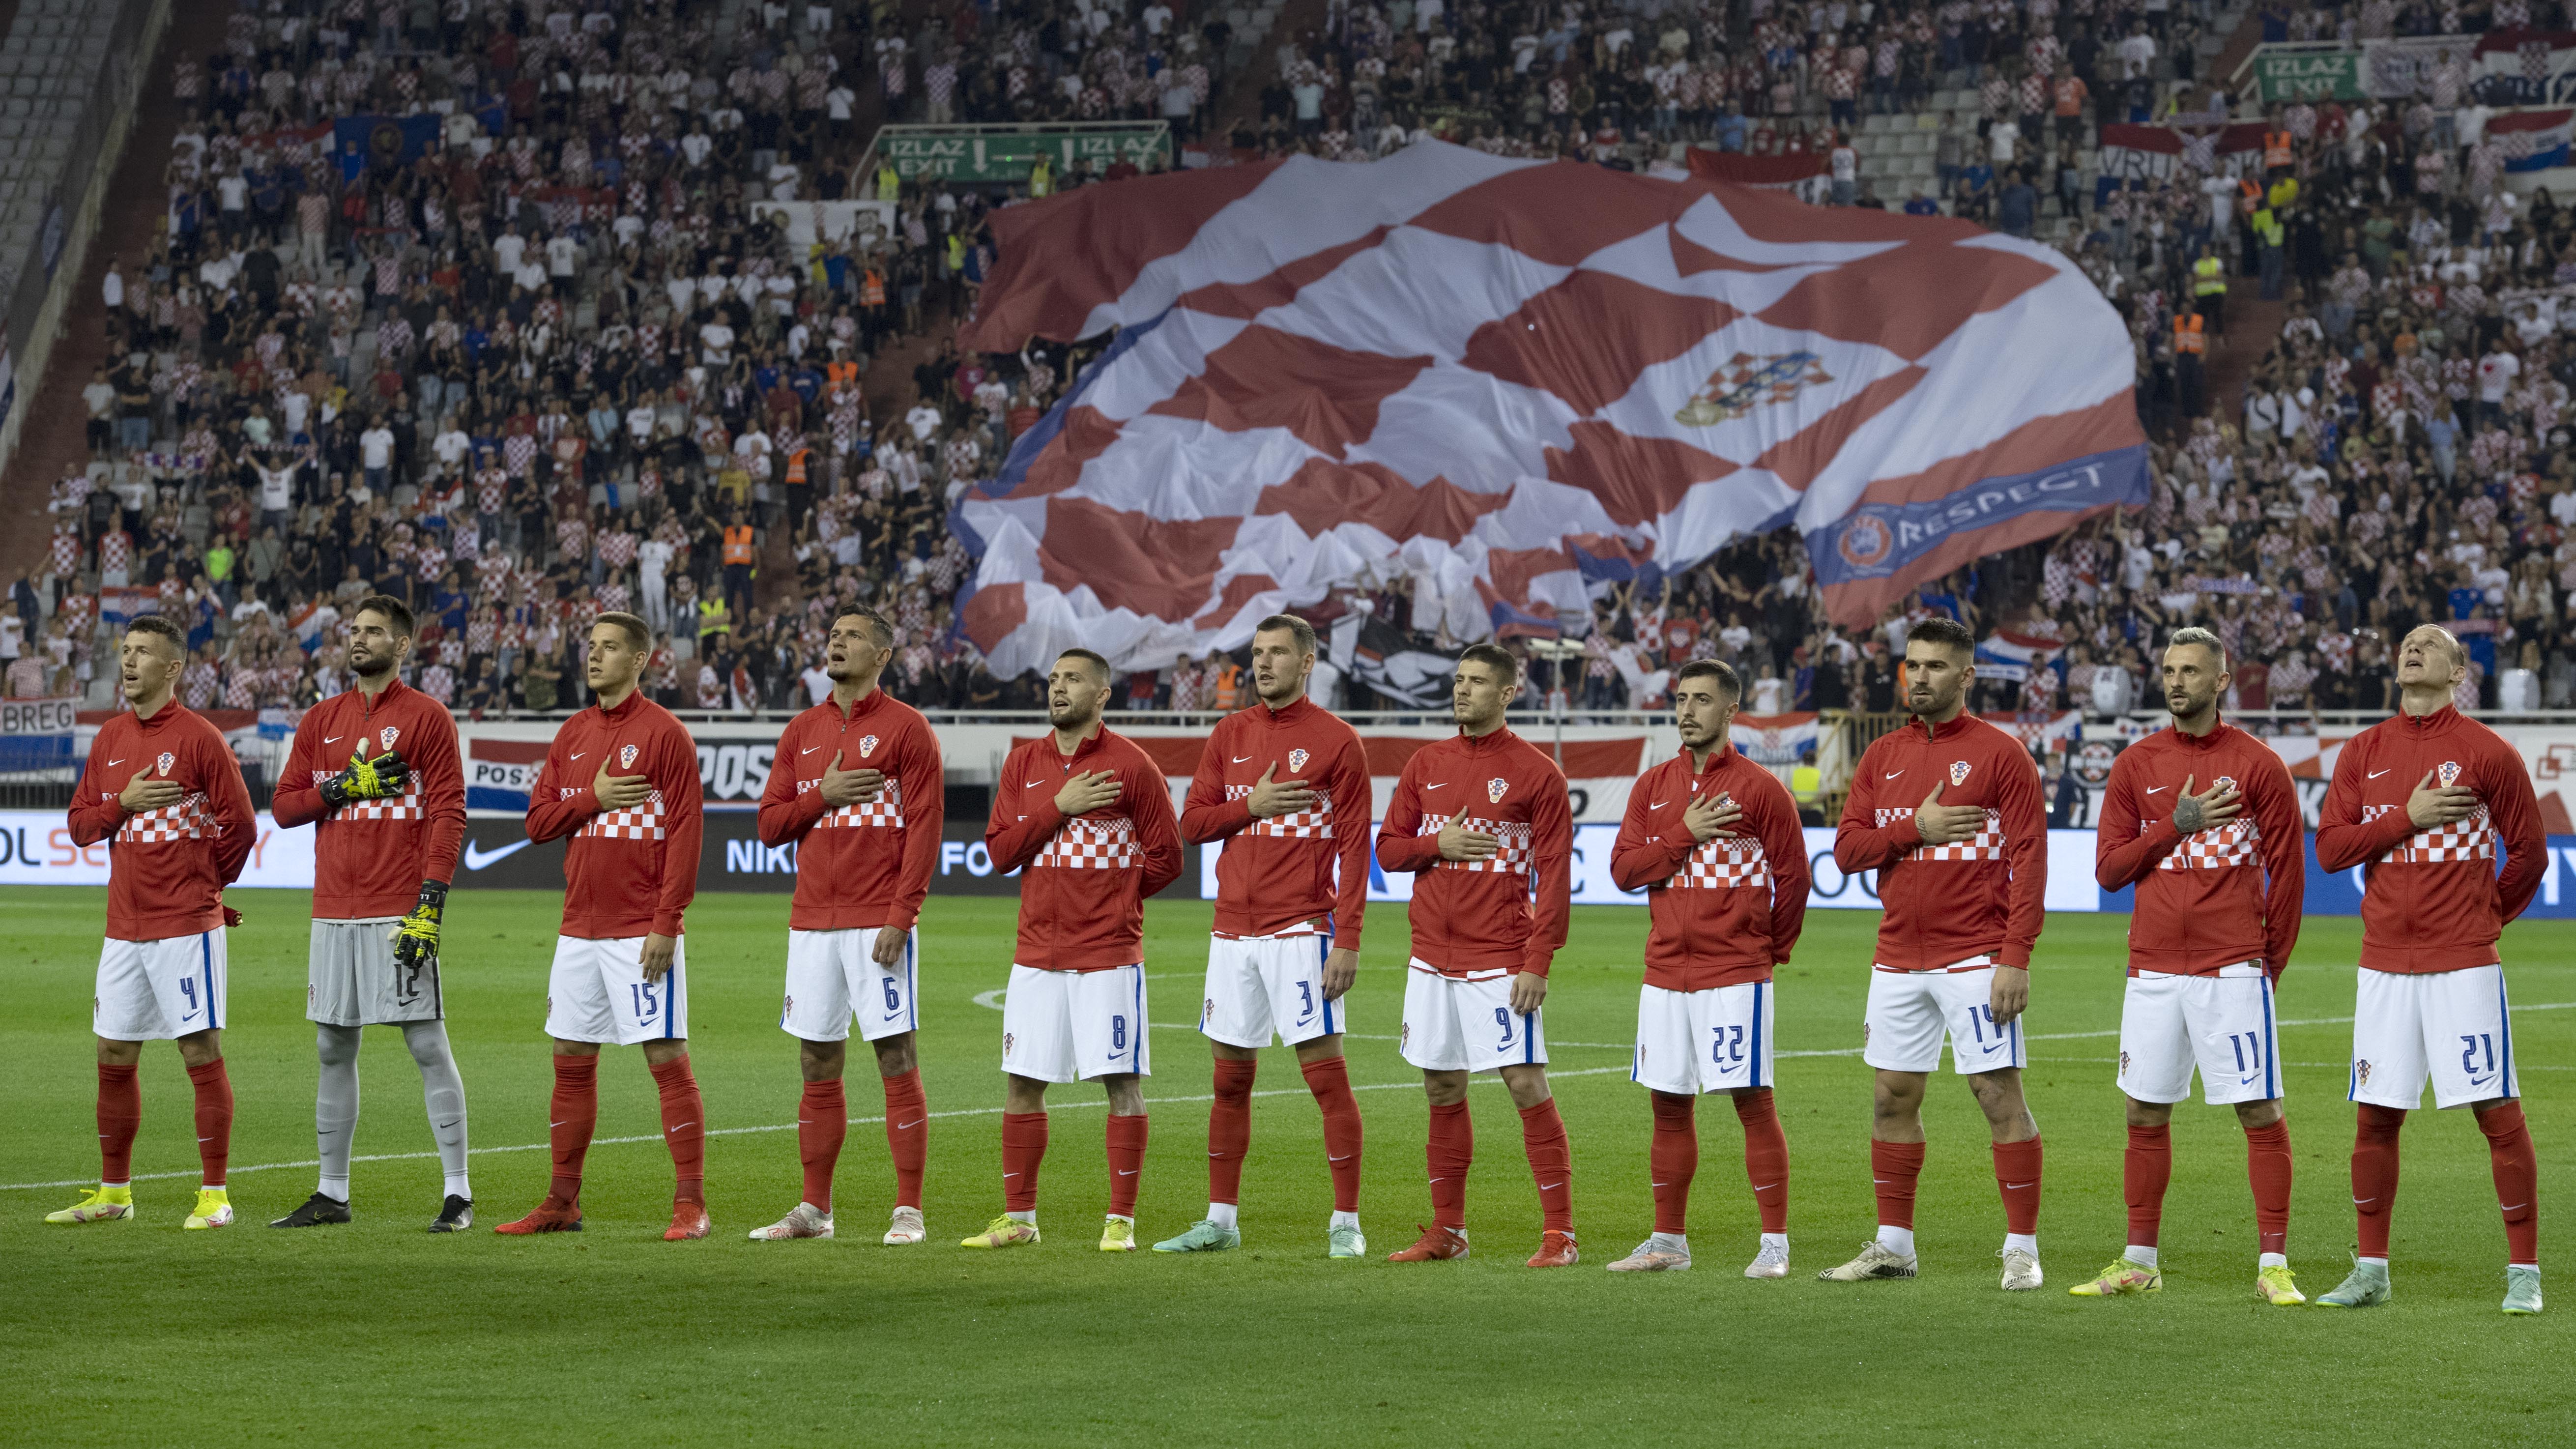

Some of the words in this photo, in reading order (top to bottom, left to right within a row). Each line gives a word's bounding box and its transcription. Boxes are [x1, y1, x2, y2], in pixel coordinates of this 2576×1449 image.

[2265, 58, 2347, 76] IZLAZ
[2277, 78, 2338, 97] EXIT
[890, 139, 966, 156] IZLAZ
[899, 158, 956, 175] EXIT
[1898, 462, 2102, 549] RESPECT
[3, 702, 71, 731] BREG
[476, 764, 522, 785] POS
[696, 745, 777, 800] POS
[726, 839, 798, 869] NIK
[180, 977, 197, 1010] 4
[394, 963, 421, 997] 12
[882, 977, 899, 1011] 6
[630, 982, 657, 1017] 15
[1296, 981, 1313, 1016] 3
[1112, 1015, 1126, 1049] 8
[1495, 1007, 1512, 1042] 9
[1968, 1004, 2003, 1043] 14
[1712, 1025, 1744, 1063] 22
[2229, 1031, 2259, 1072] 11
[2460, 1034, 2494, 1074] 21
